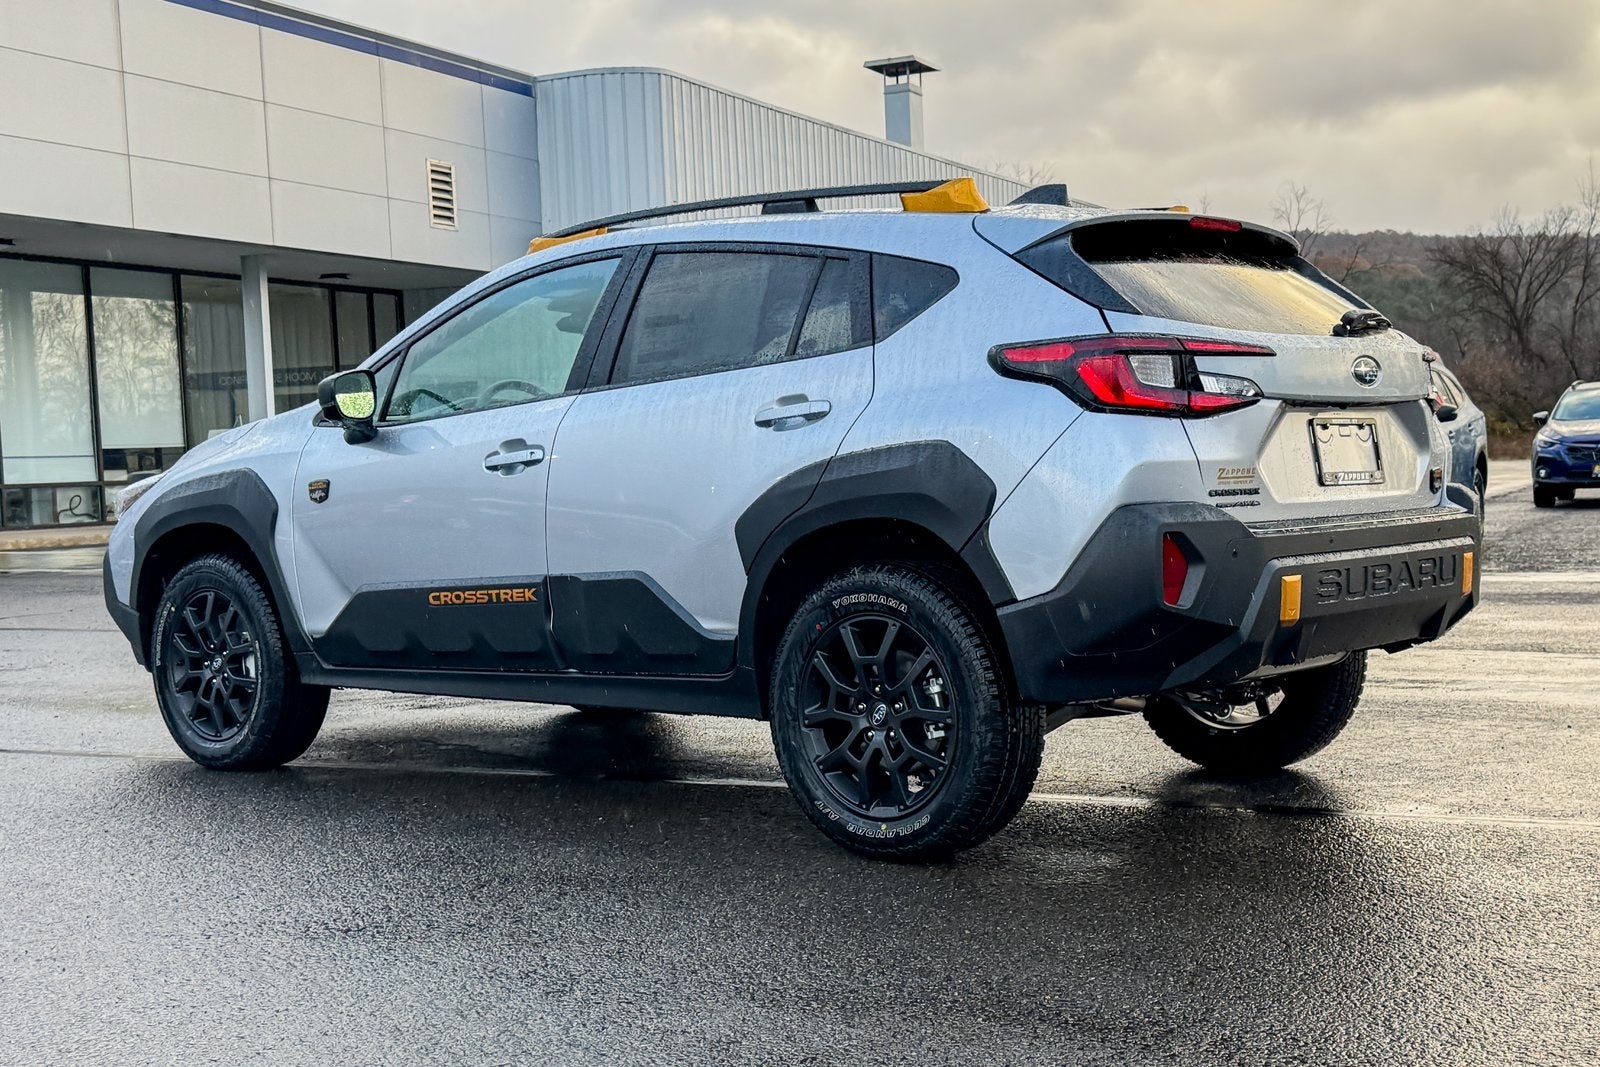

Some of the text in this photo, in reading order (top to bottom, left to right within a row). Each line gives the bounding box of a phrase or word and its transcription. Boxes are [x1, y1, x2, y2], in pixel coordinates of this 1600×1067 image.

[1217, 467, 1256, 480] ZAPPONE
[1338, 472, 1370, 484] ZAPPONE
[1208, 487, 1260, 497] CROSSTREK
[1316, 554, 1458, 605] SUBARU
[428, 587, 538, 605] CROSSTREK
[832, 593, 908, 613] YOKOHAMA
[846, 814, 931, 838] GEOLANDAR
